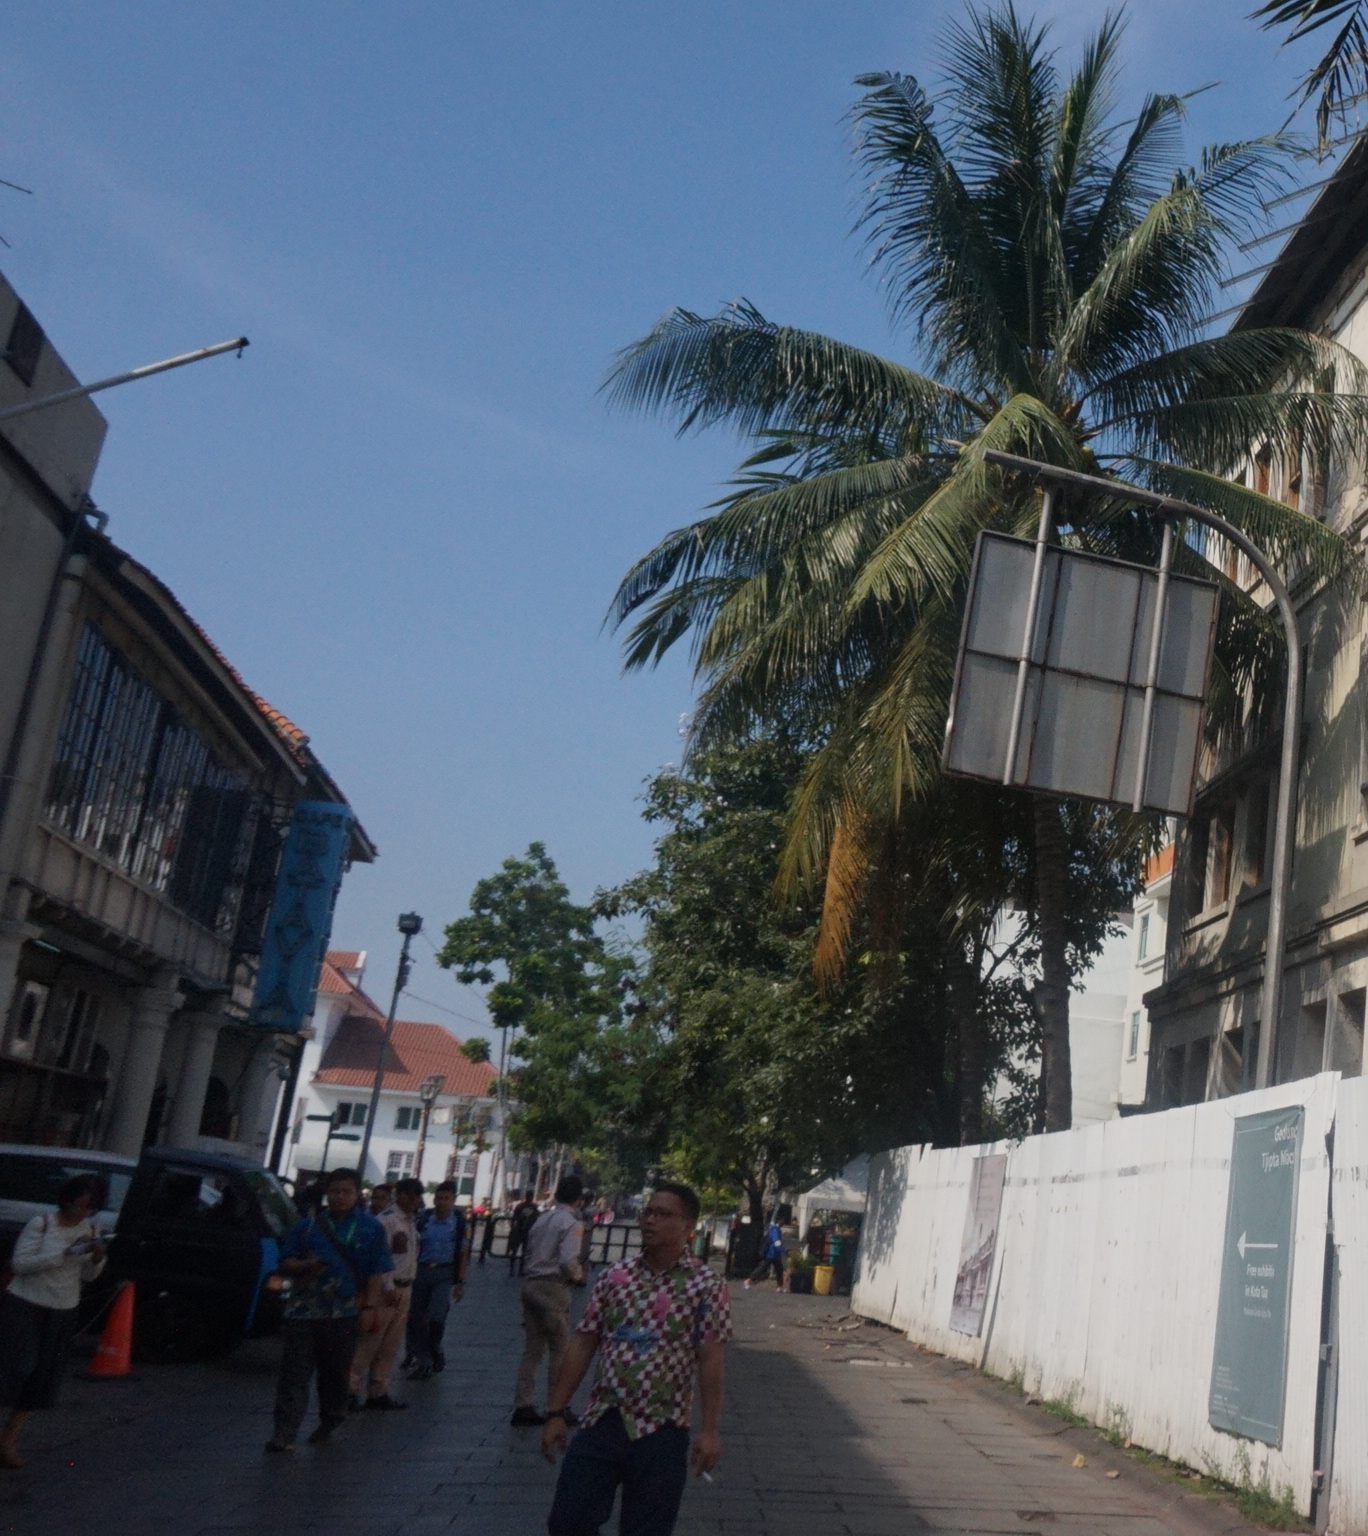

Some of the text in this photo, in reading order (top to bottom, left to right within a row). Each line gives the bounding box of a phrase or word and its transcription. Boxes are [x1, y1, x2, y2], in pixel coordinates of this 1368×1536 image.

[1246, 1263, 1257, 1277] Free
[1244, 1284, 1250, 1297] in
[1250, 1285, 1261, 1298] Kota
